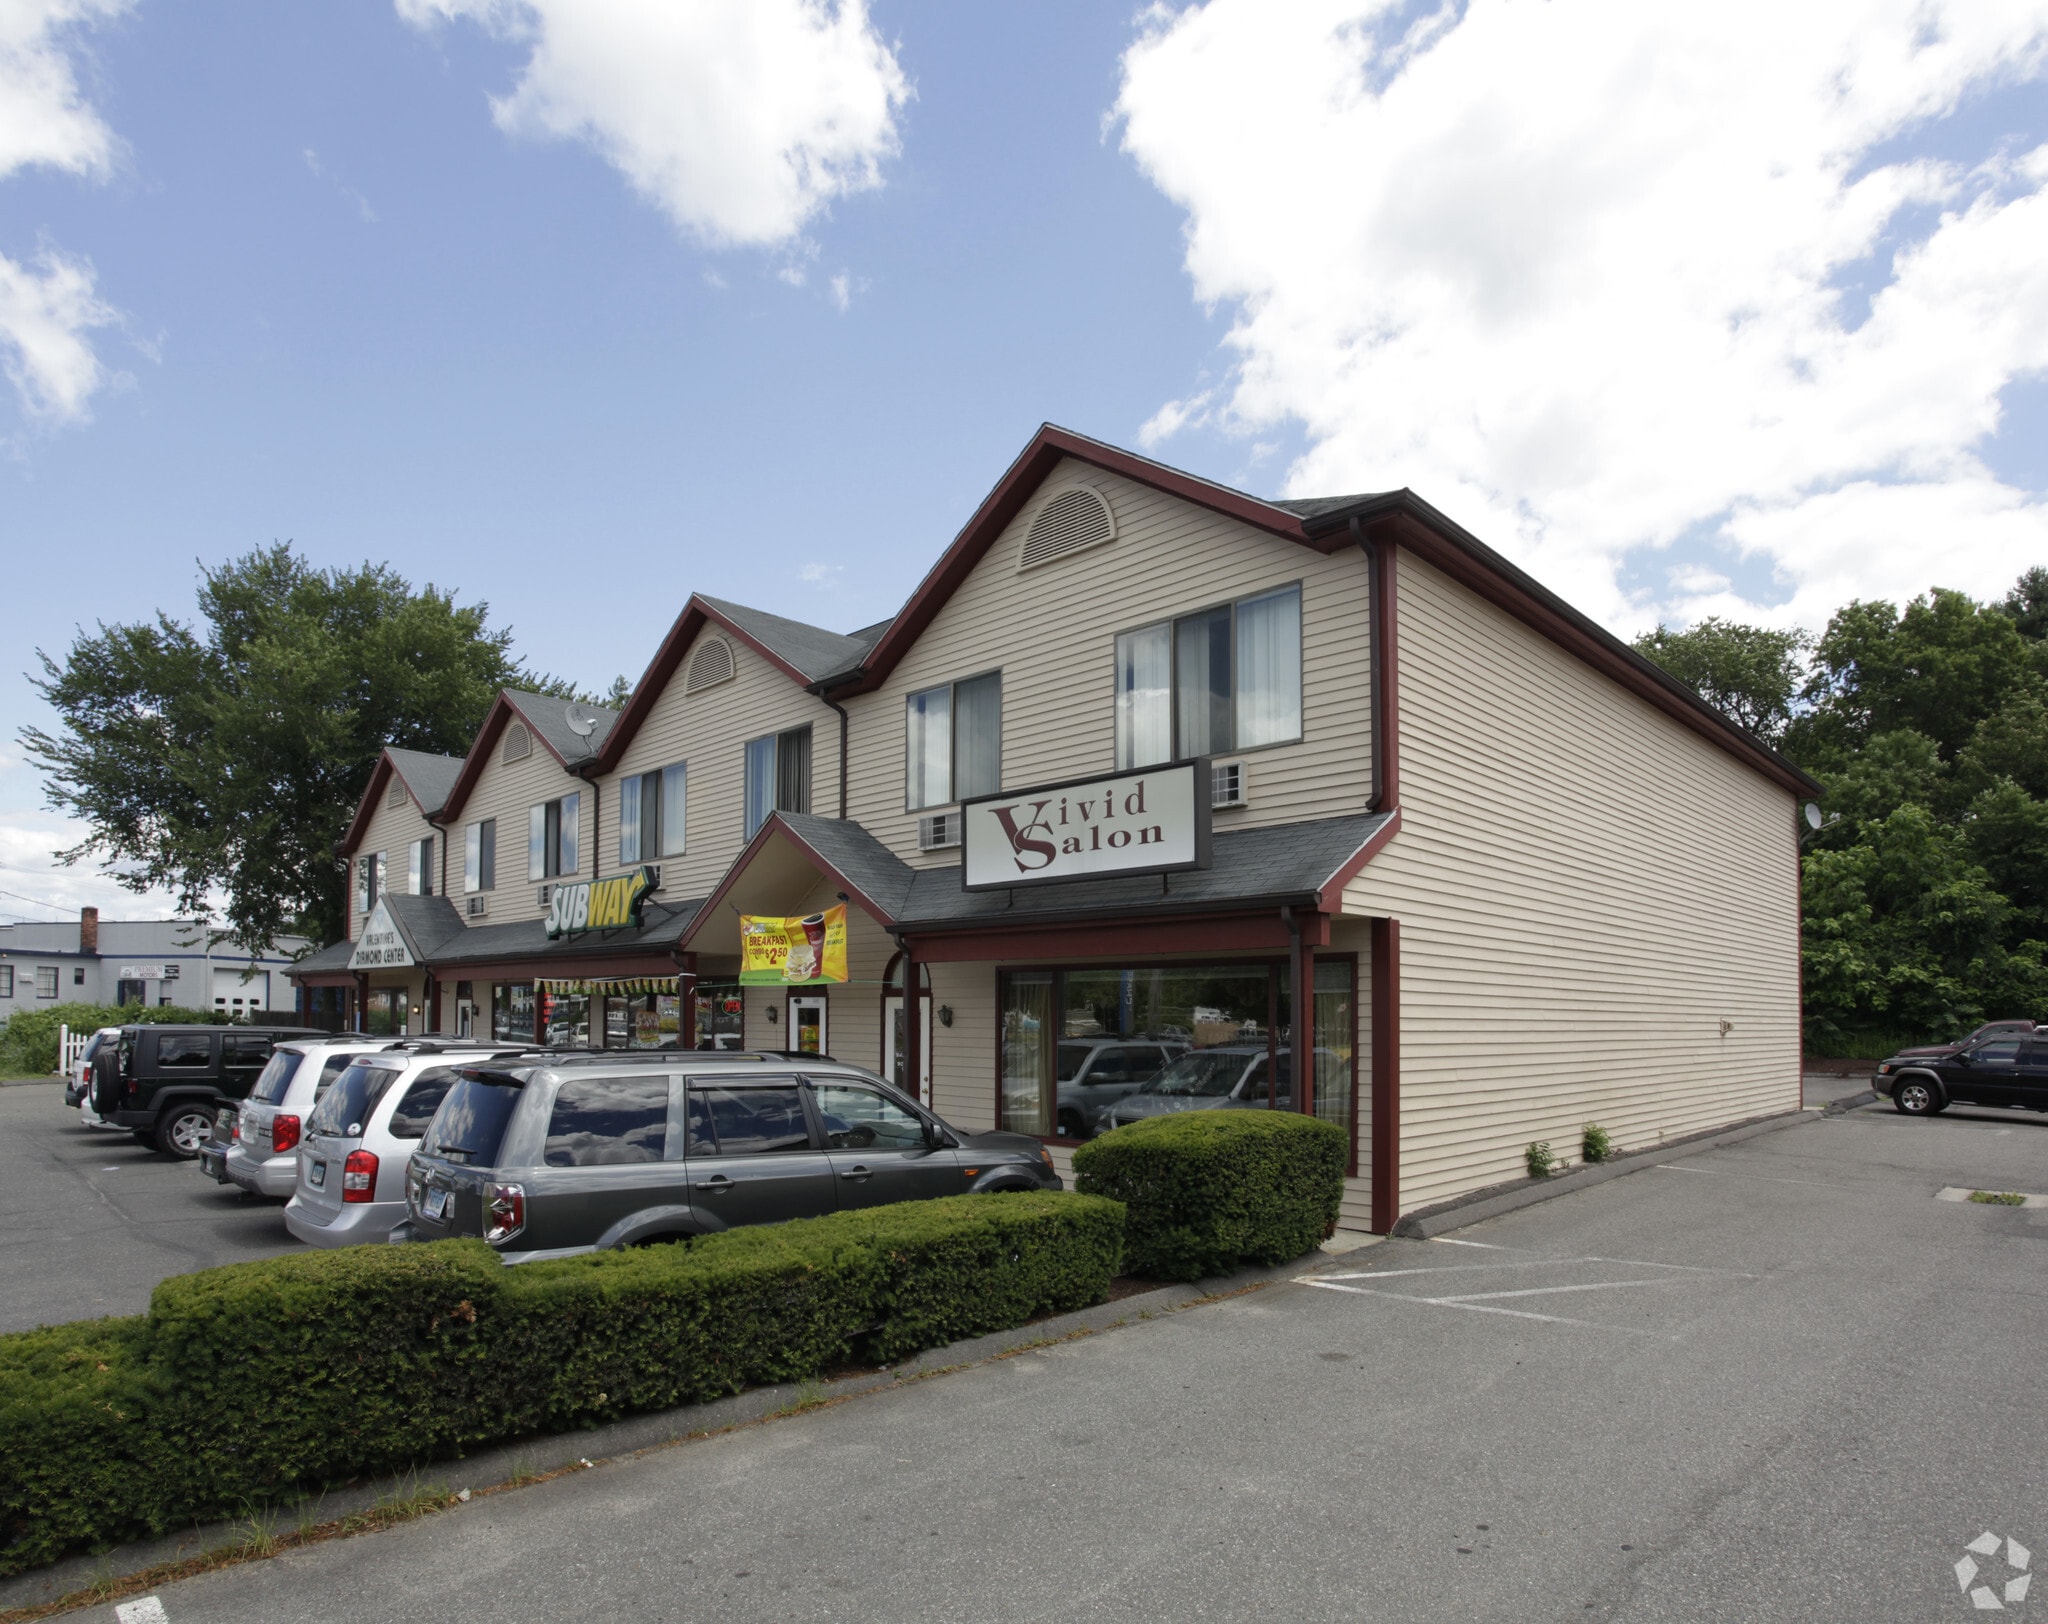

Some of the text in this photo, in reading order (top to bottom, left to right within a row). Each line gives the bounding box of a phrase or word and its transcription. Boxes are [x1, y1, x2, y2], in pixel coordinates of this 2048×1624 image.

[987, 780, 1148, 856] Vivid
[1013, 820, 1165, 874] Salon
[544, 871, 646, 936] SUBWAY
[356, 947, 405, 965] DIAMOND CENTER
[749, 935, 787, 947] BREAKFAST
